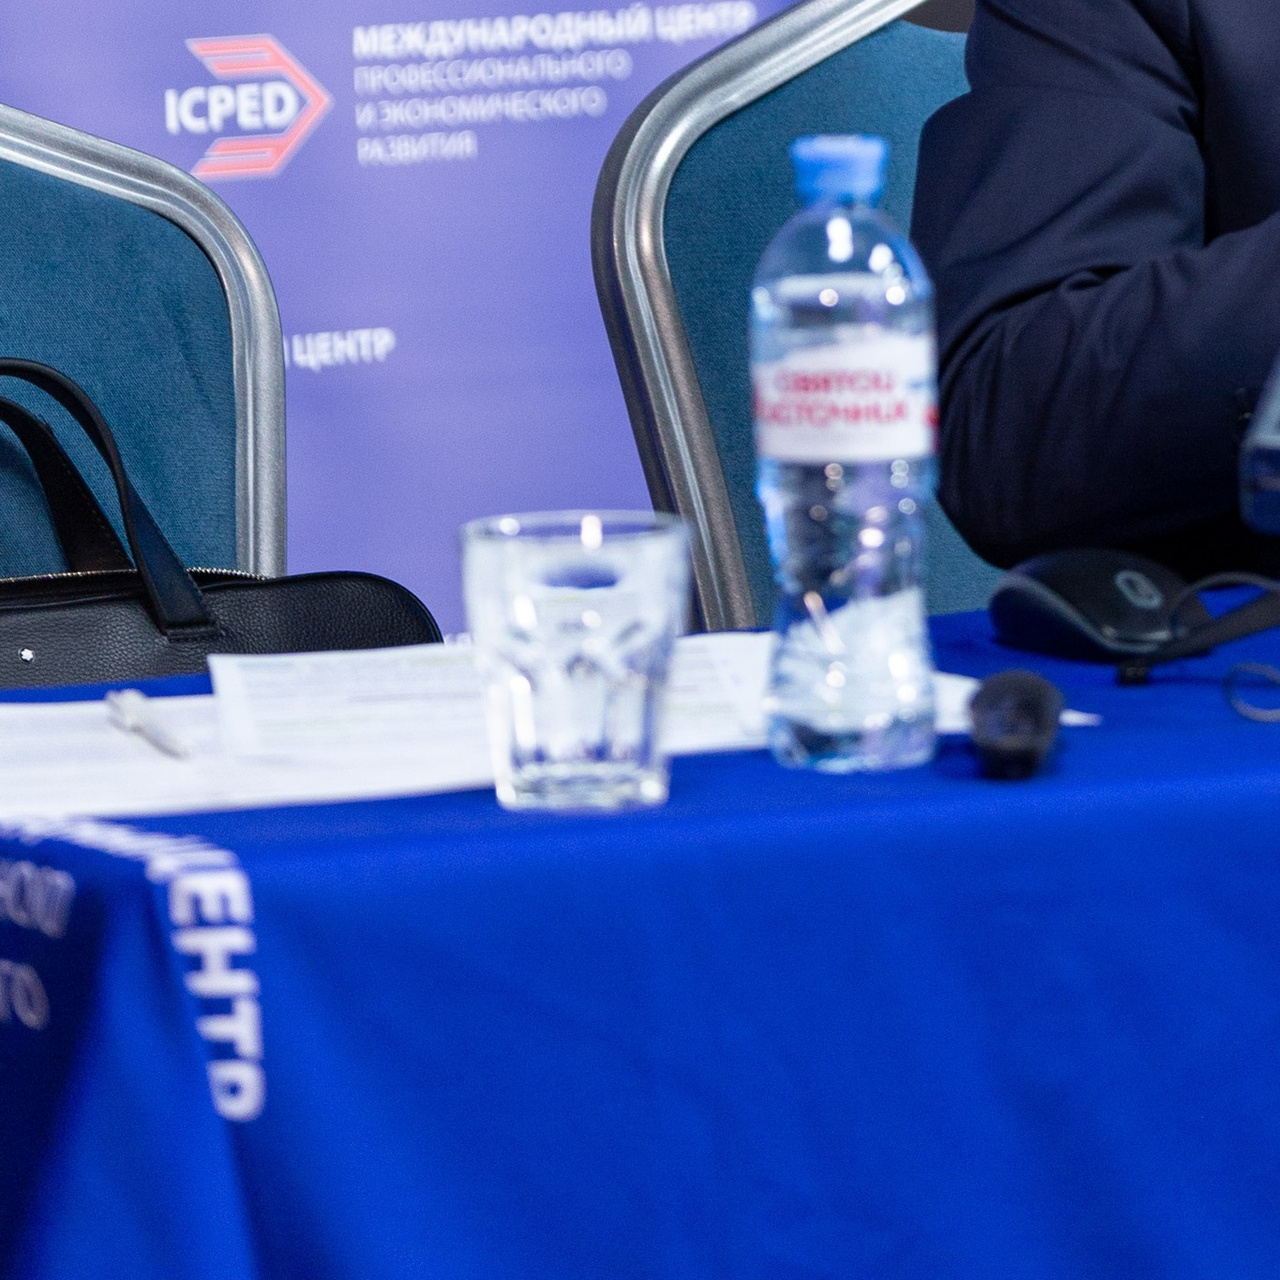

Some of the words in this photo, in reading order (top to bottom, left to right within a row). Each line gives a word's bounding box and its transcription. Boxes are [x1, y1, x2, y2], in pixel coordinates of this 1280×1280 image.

[352, 2, 653, 61] МЕЖДУНАРОДНЫЙ
[655, 0, 757, 44] ЦЕНТР
[353, 48, 634, 96] ПРОФЕССИОНАЛЬНОГО
[164, 81, 299, 135] ICPED
[355, 101, 377, 131] И
[379, 86, 608, 127] ЭКОНОМИЧЕСКОГО
[357, 130, 479, 167] РАЗВИТИЯ
[291, 326, 397, 373] ЦЕНТР
